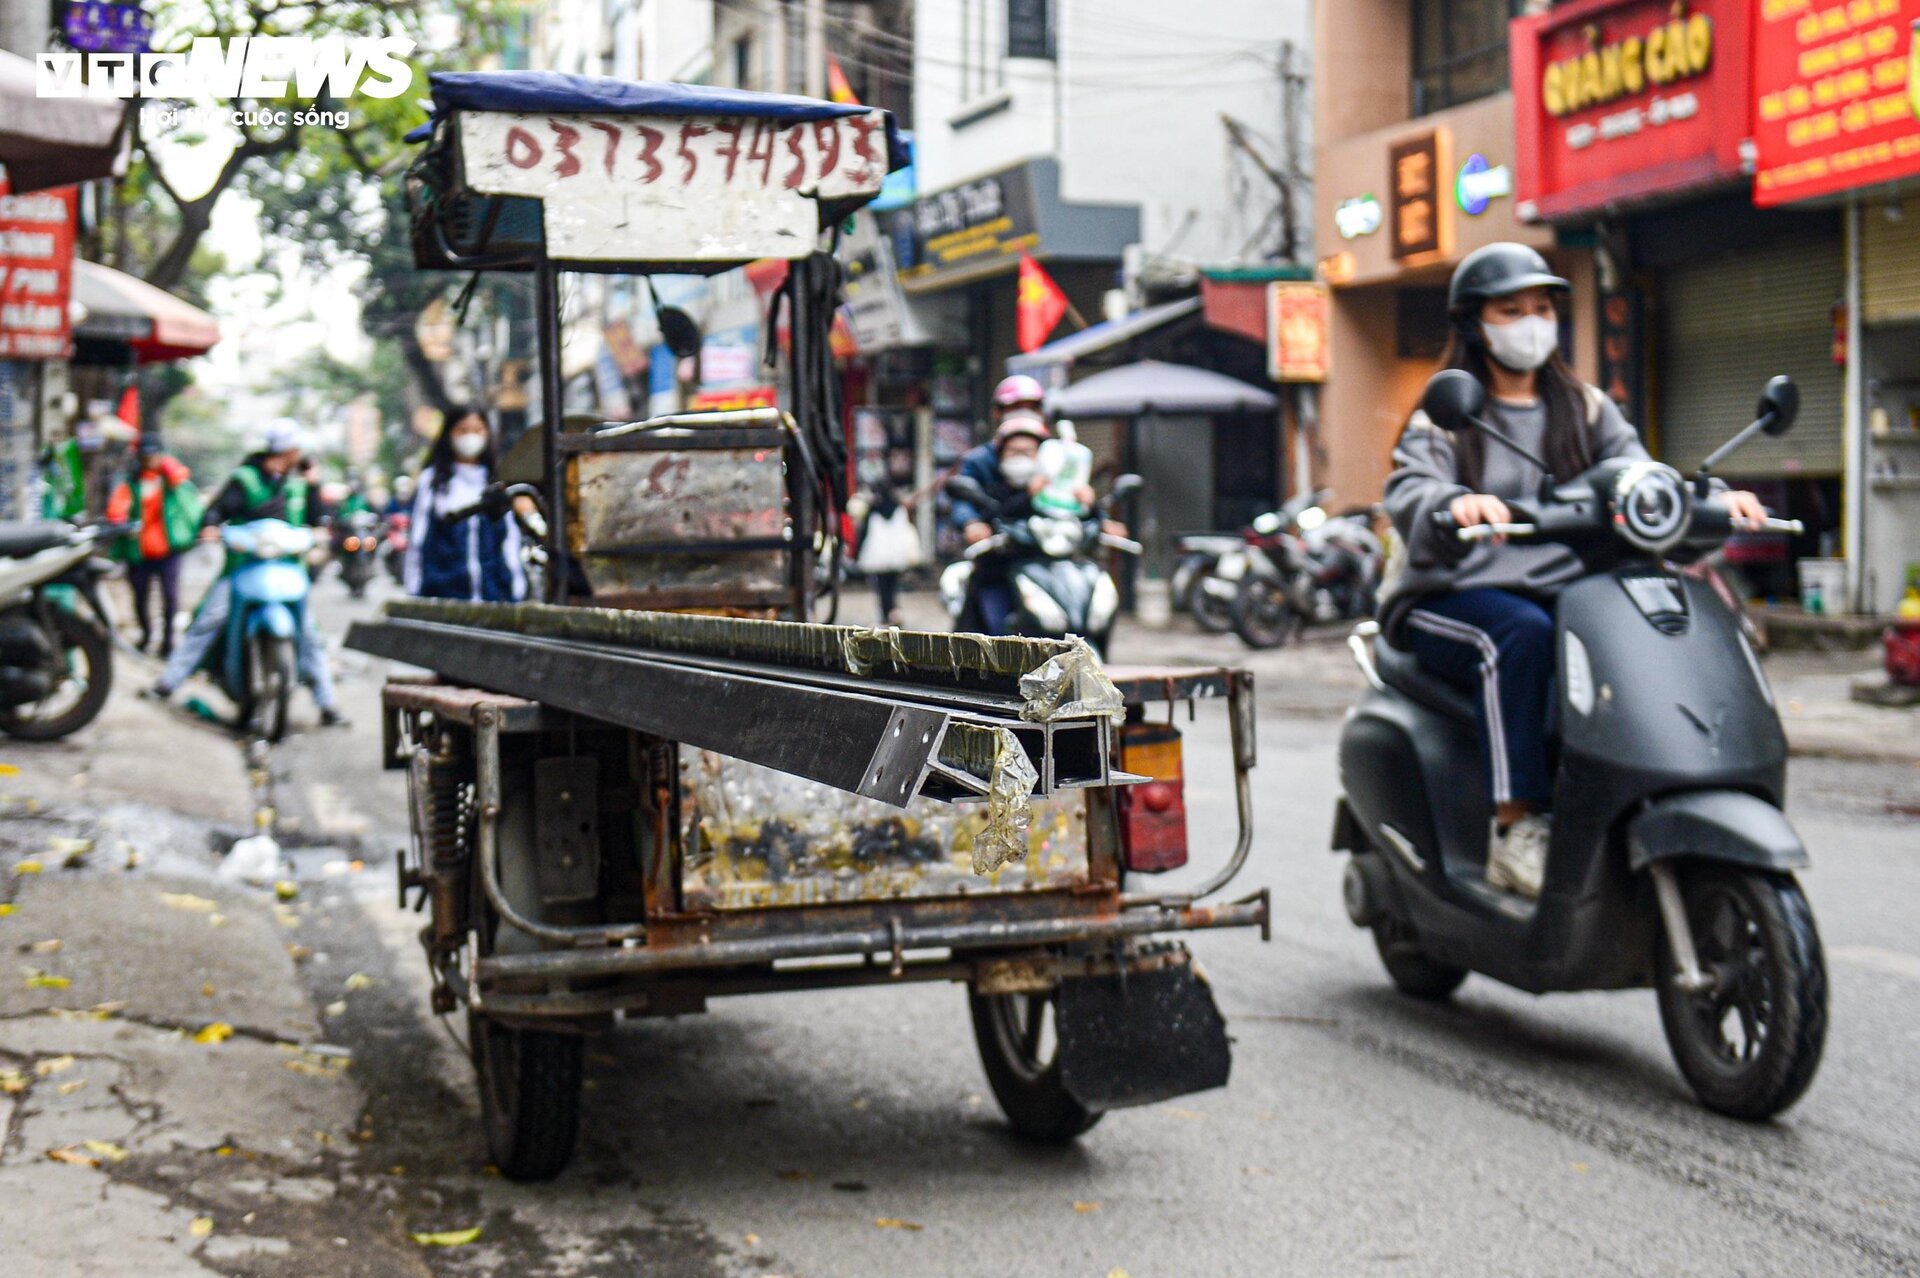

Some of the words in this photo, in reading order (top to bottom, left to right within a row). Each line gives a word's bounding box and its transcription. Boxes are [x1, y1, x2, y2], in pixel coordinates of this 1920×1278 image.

[1543, 24, 1643, 117] QUẢNG
[1645, 1, 1712, 84] CÁO
[506, 116, 880, 189] 0373574393
